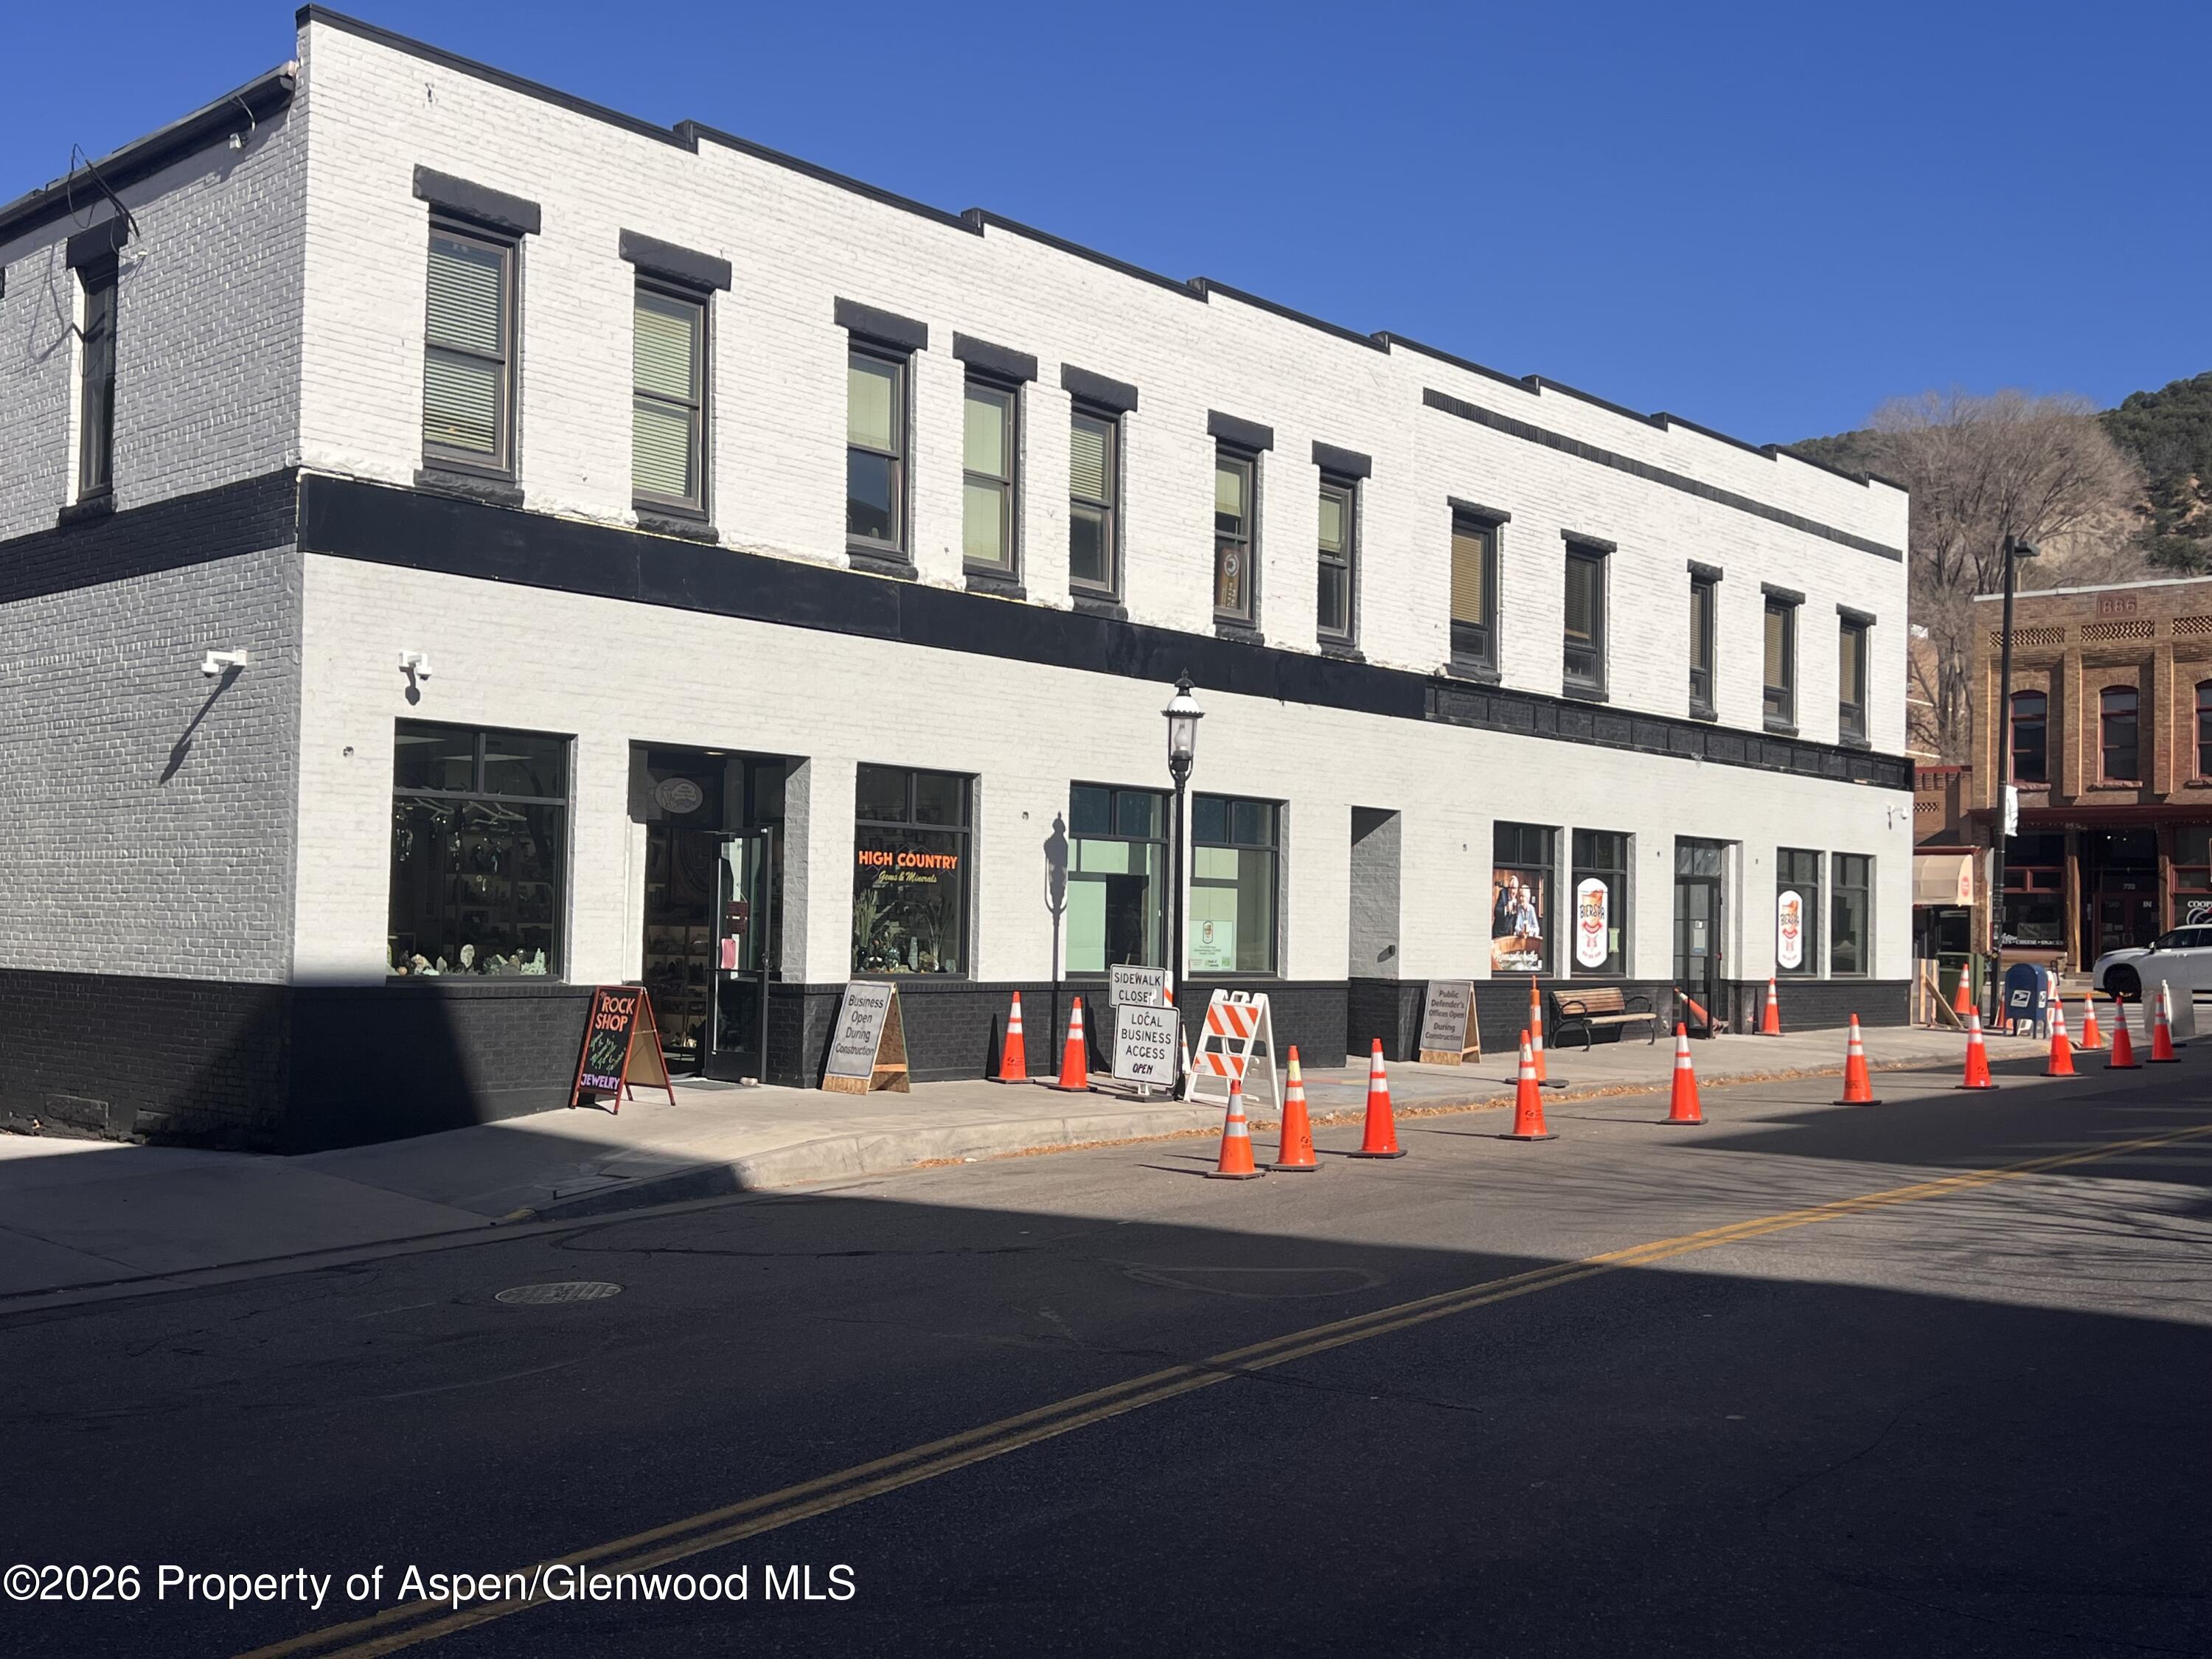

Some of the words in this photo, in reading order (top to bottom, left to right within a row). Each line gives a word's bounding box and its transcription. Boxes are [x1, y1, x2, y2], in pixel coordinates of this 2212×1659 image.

[2098, 598, 2135, 614] 1886
[858, 851, 893, 866] HIGH
[897, 852, 958, 869] COUNTRY
[878, 871, 898, 883] Gems
[899, 872, 905, 882] &
[905, 872, 937, 883] Minerals
[1579, 904, 1605, 920] BIERSPA
[1114, 972, 1161, 987] SIDEWALK
[848, 995, 884, 1008] Business
[1119, 990, 1155, 1004] CLOSE
[1439, 990, 1459, 998] Public
[601, 996, 635, 1015] ROCK
[1430, 999, 1464, 1009] Defender's
[851, 1011, 872, 1026] Open
[1131, 1013, 1163, 1028] LOCAL
[1429, 1009, 1448, 1018] Offices
[1449, 1010, 1464, 1019] Open
[595, 1013, 628, 1032] SHOP
[1433, 1022, 1456, 1033] During
[846, 1027, 871, 1043] During
[1121, 1029, 1172, 1045] BUSINESS
[1425, 1032, 1461, 1041] Construction
[835, 1043, 874, 1056] Construction
[1125, 1045, 1165, 1060] ACCESS
[1132, 1062, 1153, 1075] OPEN
[580, 1074, 620, 1091] JEWELRY
